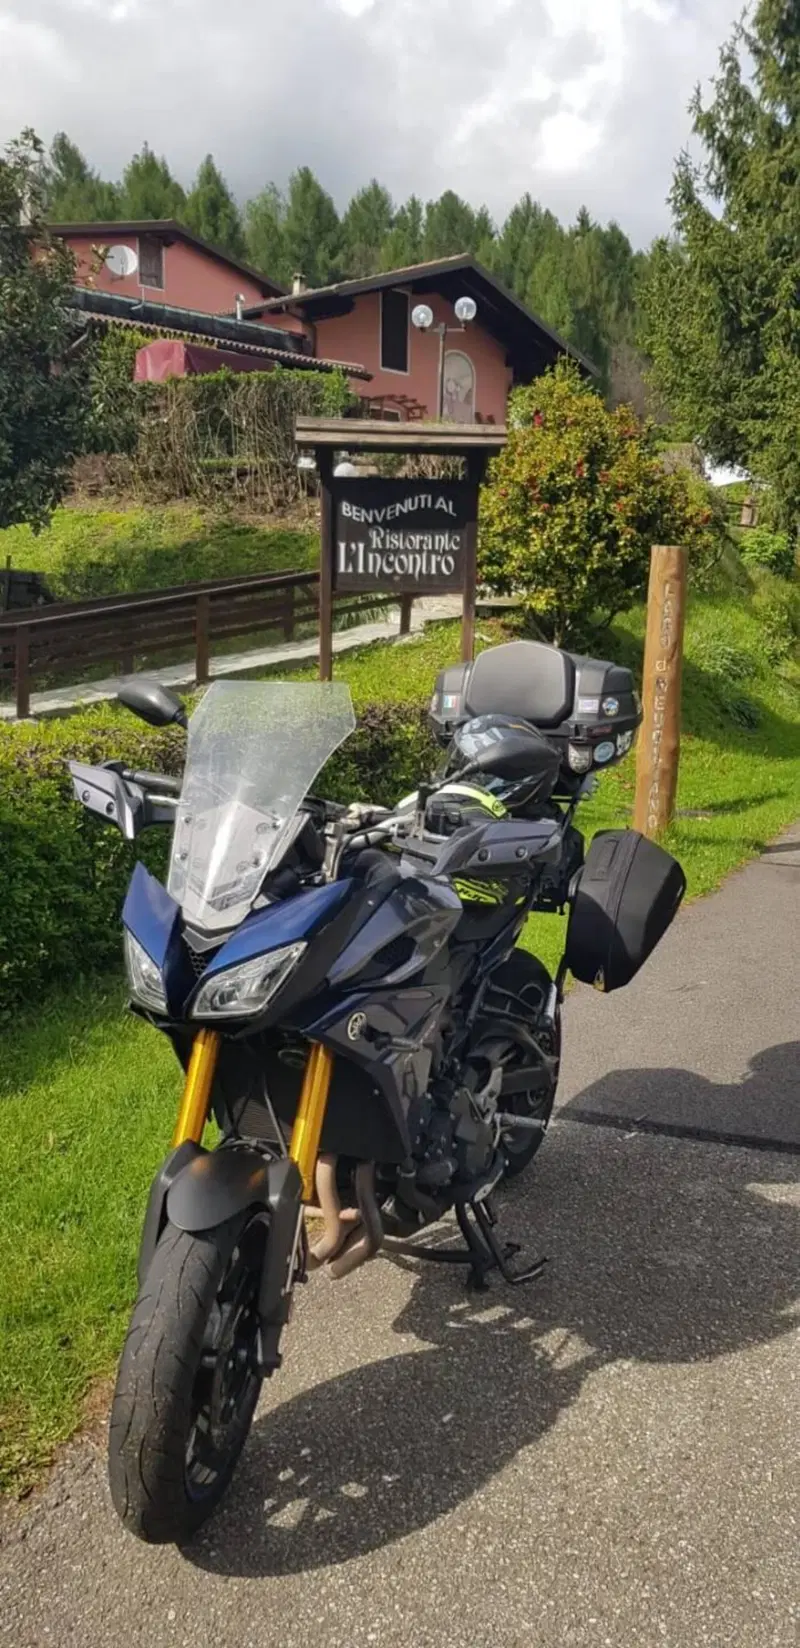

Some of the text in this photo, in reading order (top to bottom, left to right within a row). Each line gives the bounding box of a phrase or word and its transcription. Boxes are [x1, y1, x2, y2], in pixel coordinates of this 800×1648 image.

[341, 494, 457, 523] BENVENUTI AL
[368, 525, 461, 554] Ristorante
[338, 541, 455, 581] L'Incontro
